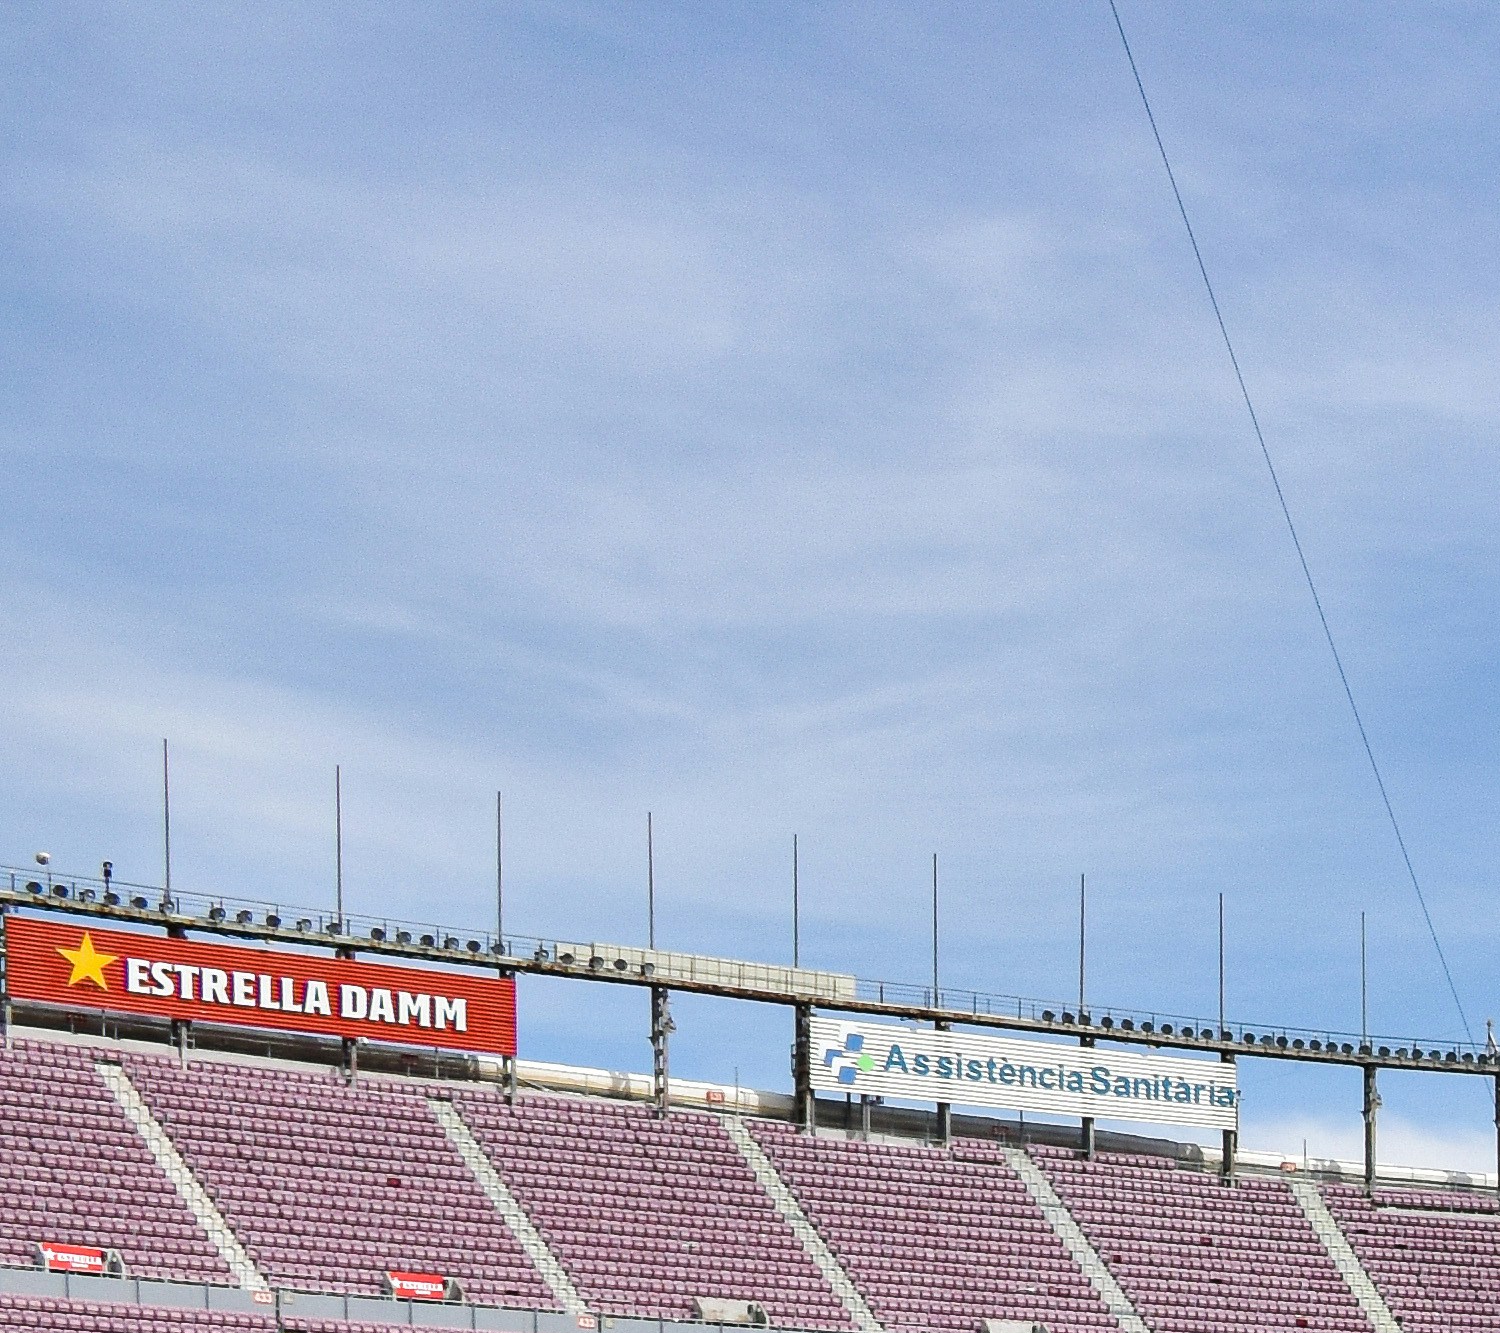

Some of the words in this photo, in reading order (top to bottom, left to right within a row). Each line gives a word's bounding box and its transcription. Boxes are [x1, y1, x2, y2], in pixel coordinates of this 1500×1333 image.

[126, 957, 331, 1016] ESTRELLA
[341, 984, 467, 1032] DAMM
[884, 1043, 1083, 1093] Assistència
[1089, 1066, 1236, 1108] Sanitària
